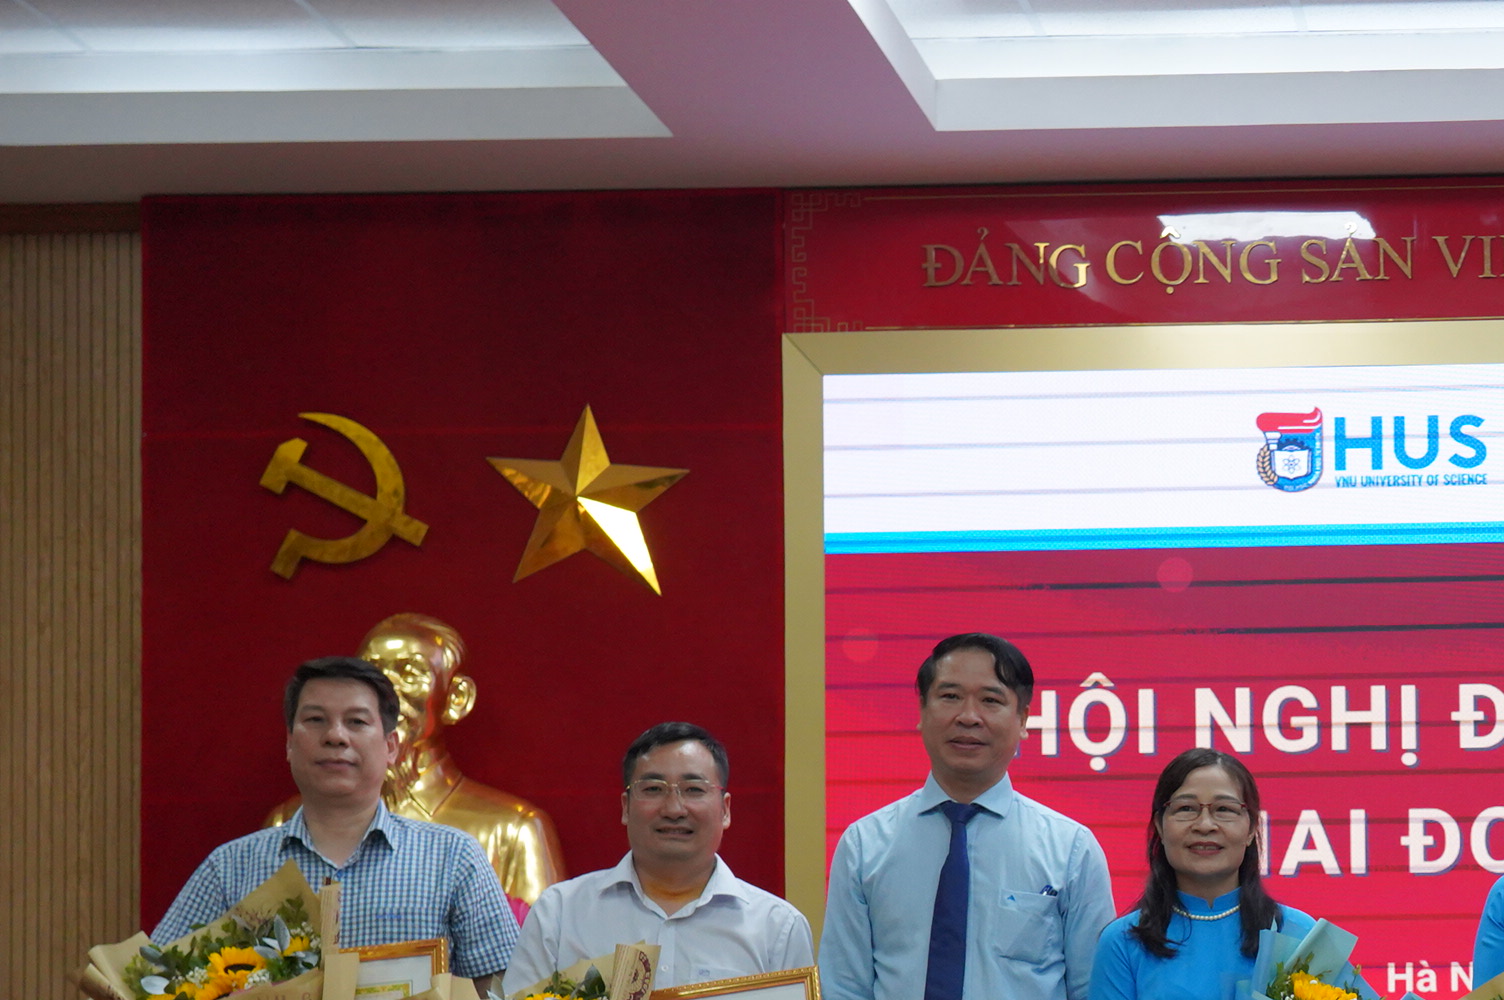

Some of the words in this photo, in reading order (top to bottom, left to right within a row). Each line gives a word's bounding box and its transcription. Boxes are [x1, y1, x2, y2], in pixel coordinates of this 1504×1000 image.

[921, 226, 1091, 289] ĐẢNG
[1105, 225, 1282, 294] CỘNG
[1301, 221, 1416, 284] SẢN
[1334, 414, 1487, 471] HUS
[1335, 475, 1357, 488] VNU
[1361, 474, 1423, 488] UNIVERSITY
[1426, 474, 1439, 486] OF
[1443, 473, 1488, 486] SCIENCE
[1195, 684, 1420, 767] NGHỊ
[1387, 960, 1438, 993] Hà
